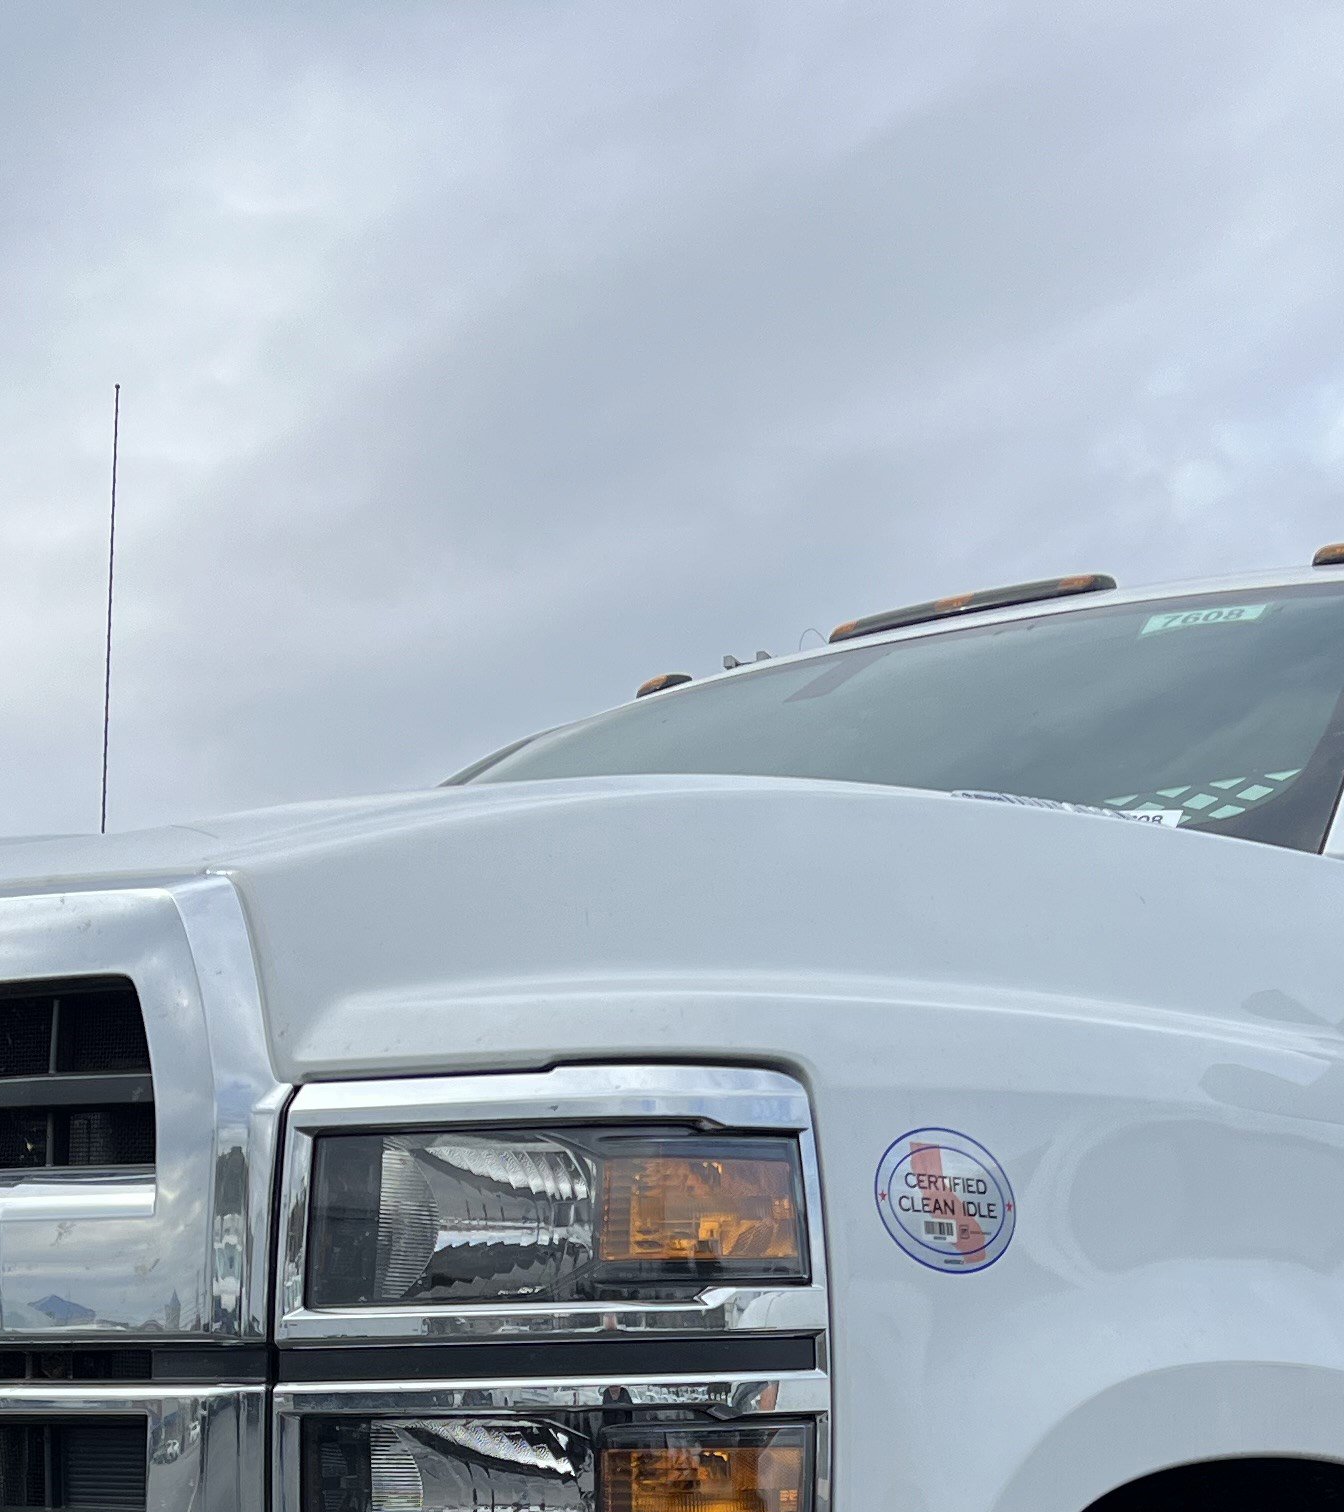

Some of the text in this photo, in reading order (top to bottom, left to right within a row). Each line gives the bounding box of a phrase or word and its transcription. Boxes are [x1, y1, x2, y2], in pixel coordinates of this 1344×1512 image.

[1160, 608, 1246, 628] 7608
[904, 1172, 988, 1195] CERTIFIED
[898, 1195, 998, 1220] CLEAN IDLE
